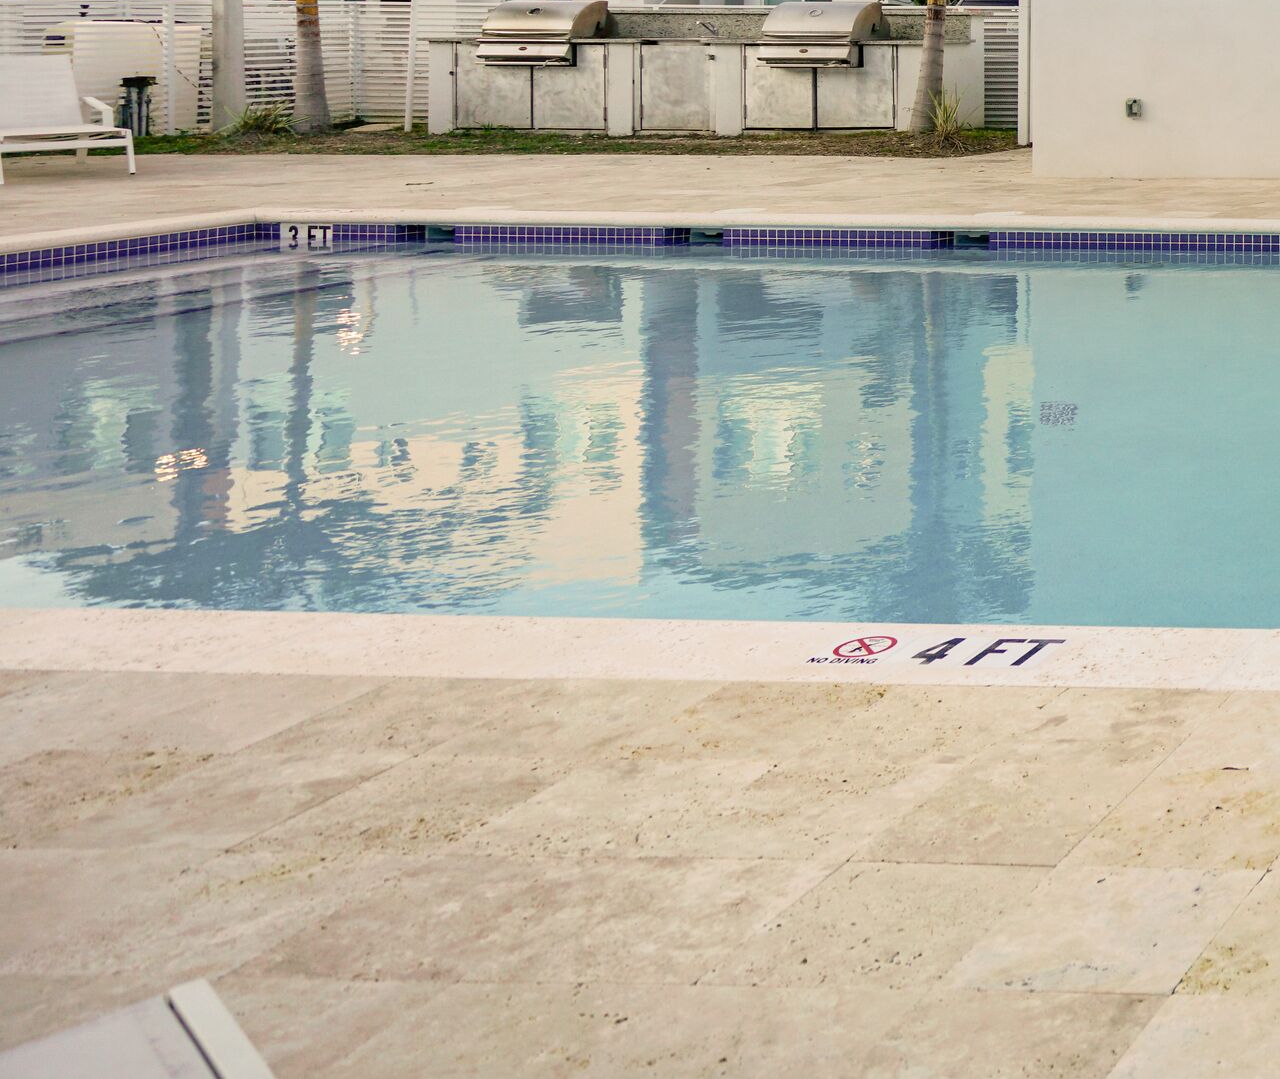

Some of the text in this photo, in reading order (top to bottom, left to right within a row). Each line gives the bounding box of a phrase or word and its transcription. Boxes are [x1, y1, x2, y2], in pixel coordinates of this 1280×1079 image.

[308, 225, 331, 242] FT
[912, 638, 1067, 666] 4 FT
